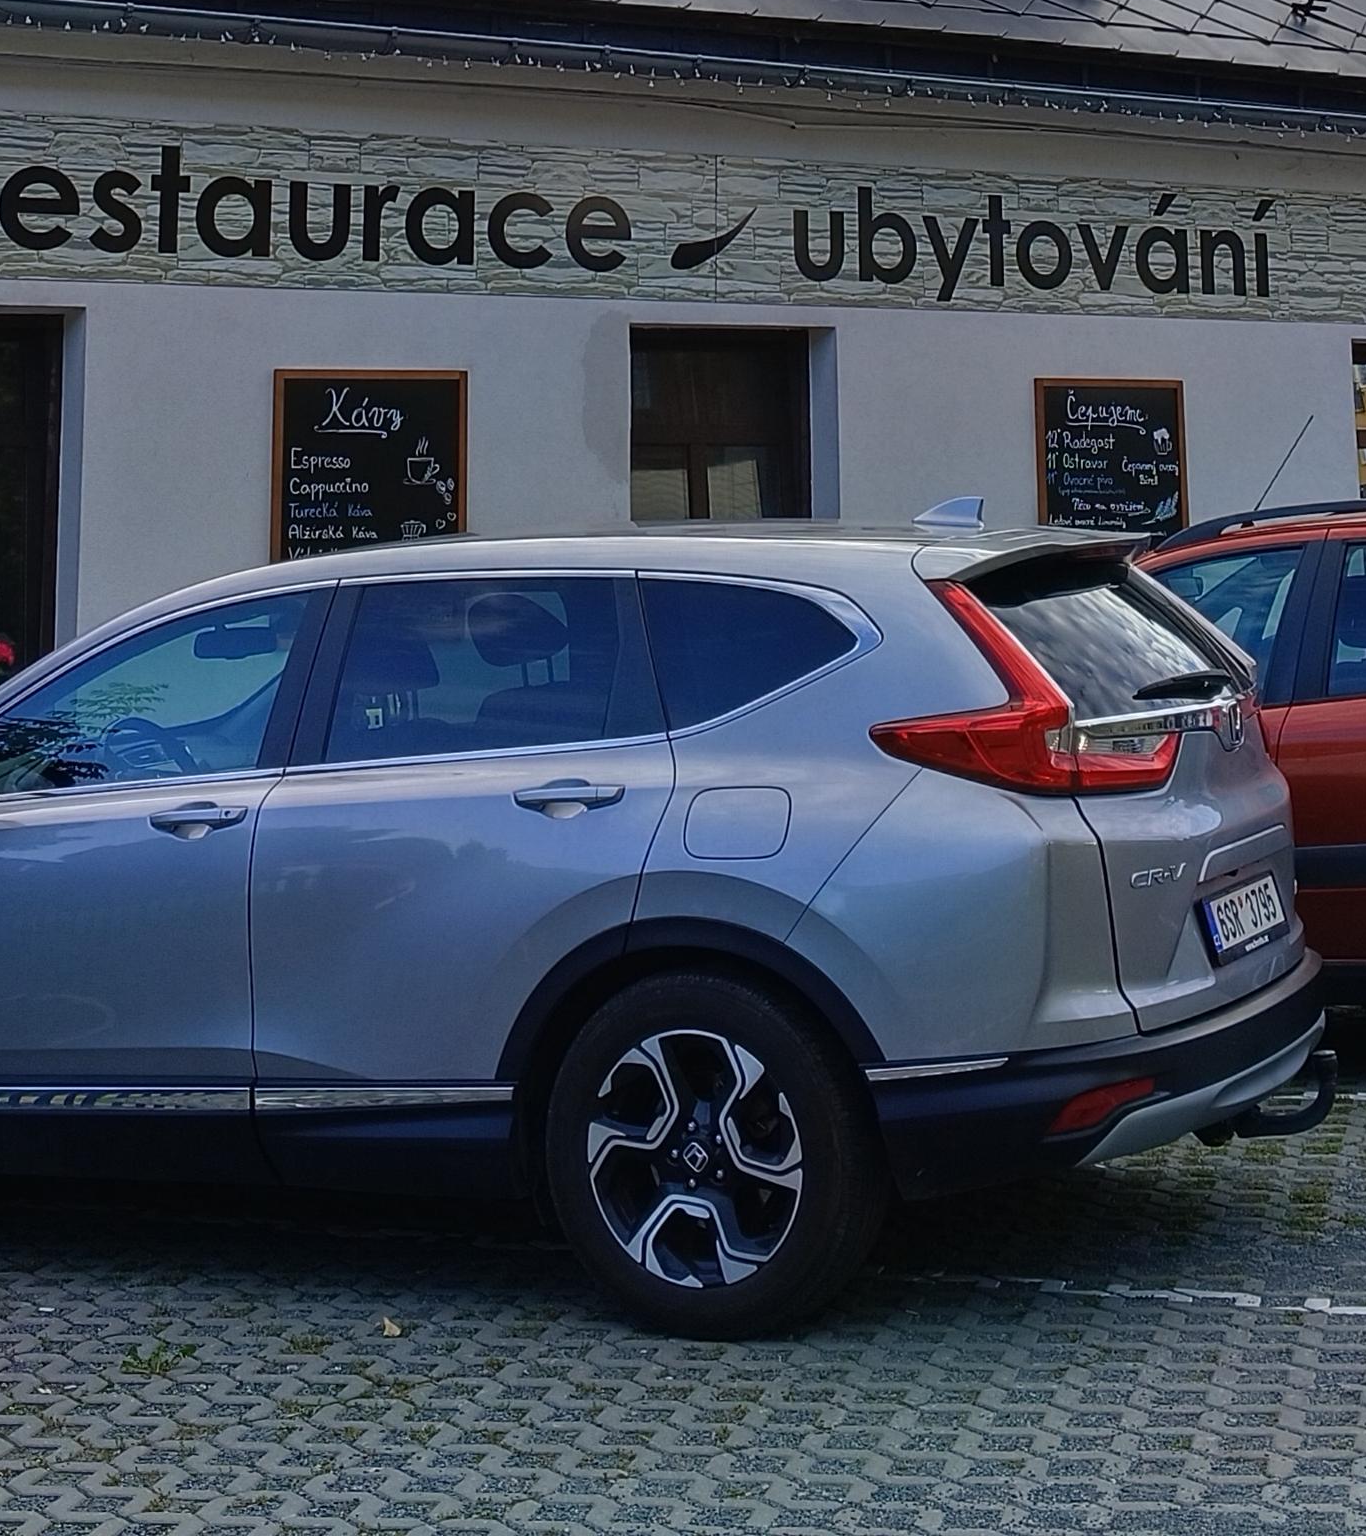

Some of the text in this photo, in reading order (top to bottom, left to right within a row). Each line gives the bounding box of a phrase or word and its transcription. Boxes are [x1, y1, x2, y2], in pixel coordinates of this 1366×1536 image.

[792, 186, 1275, 302] ubytování
[322, 387, 404, 431] Kávy
[1063, 431, 1115, 454] Radegast
[291, 447, 351, 474] Espresso
[1063, 453, 1108, 469] Ostravar
[289, 477, 369, 501] Cappuccino
[1130, 862, 1186, 889] CR-V
[1216, 899, 1245, 942] 6SR
[1245, 883, 1277, 929] 3795
